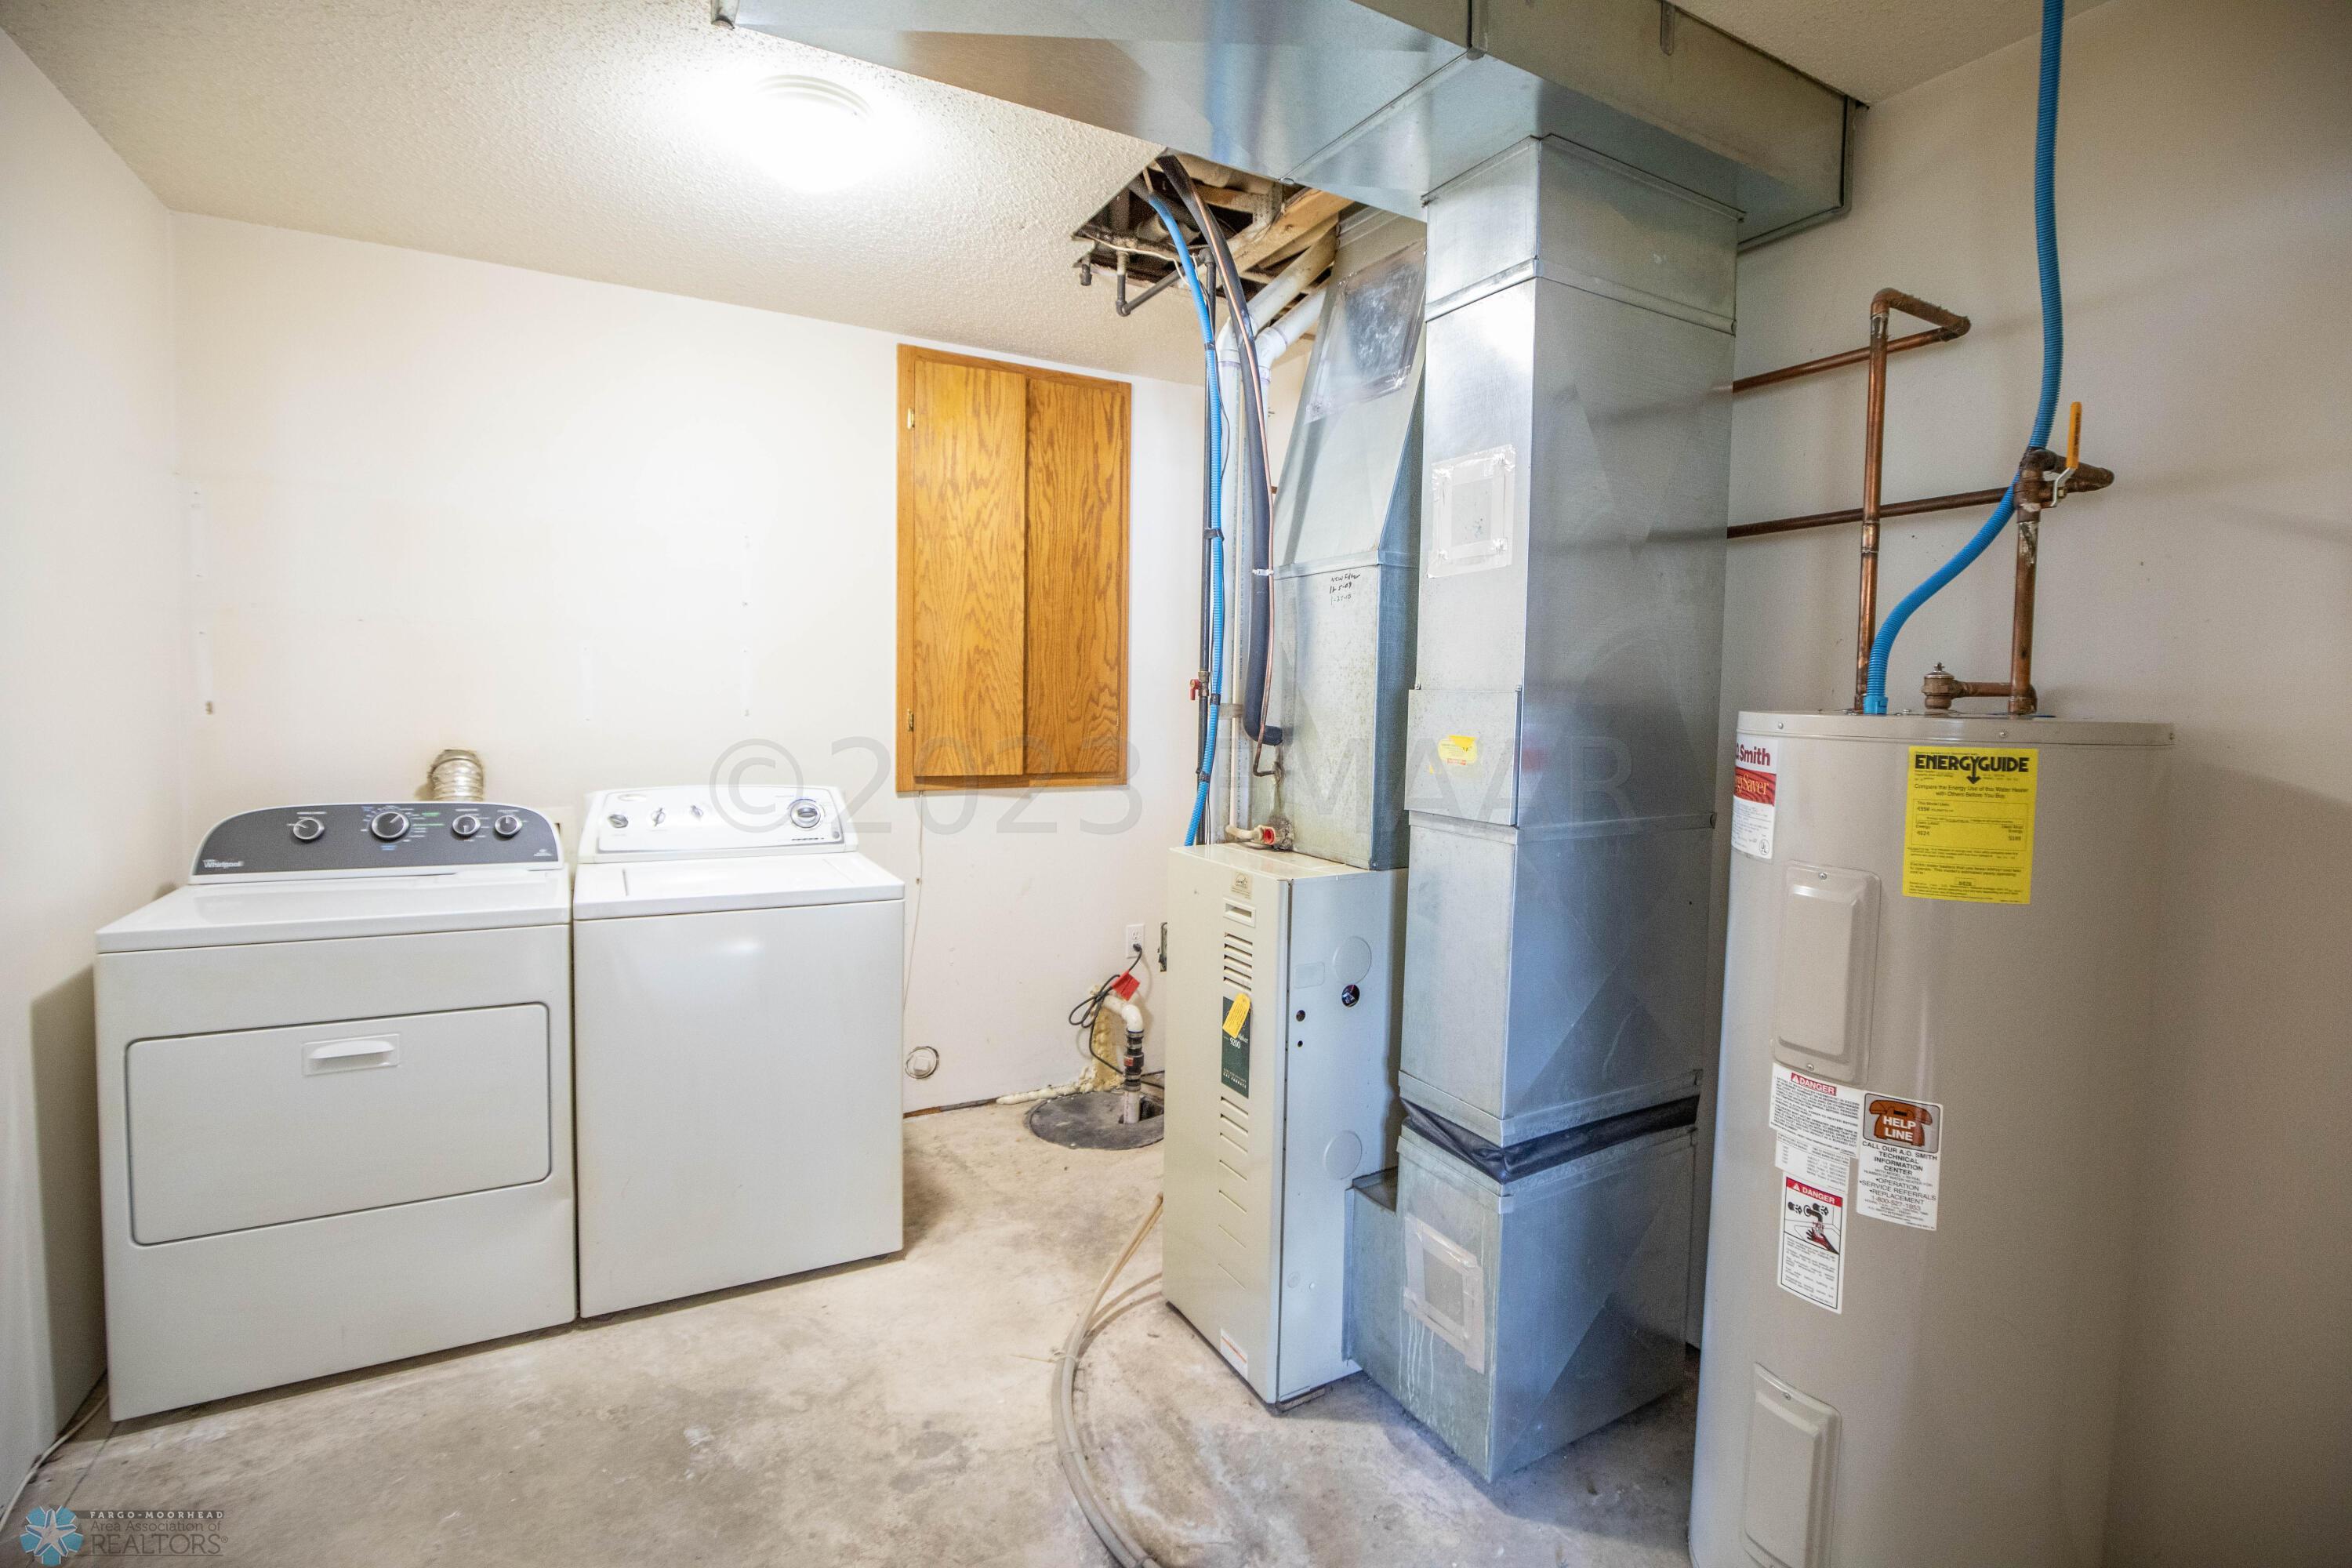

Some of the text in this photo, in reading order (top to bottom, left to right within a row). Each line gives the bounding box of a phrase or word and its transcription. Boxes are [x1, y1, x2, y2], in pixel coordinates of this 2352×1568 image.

[1915, 754, 2030, 773] ENERGYGUIDE
[1799, 1076, 1835, 1095] DANGER
[1883, 1115, 1916, 1130] HELP
[1885, 1127, 1914, 1142] LINE
[1862, 1140, 1880, 1150] CALL
[1882, 1145, 1897, 1153] OUR
[1915, 1152, 1938, 1161] SMITH
[1878, 1151, 1919, 1164] TECHNICAL
[1874, 1156, 1924, 1171] INFORMATION
[1884, 1165, 1913, 1175] CENTER
[1802, 1186, 1835, 1204] DANGER
